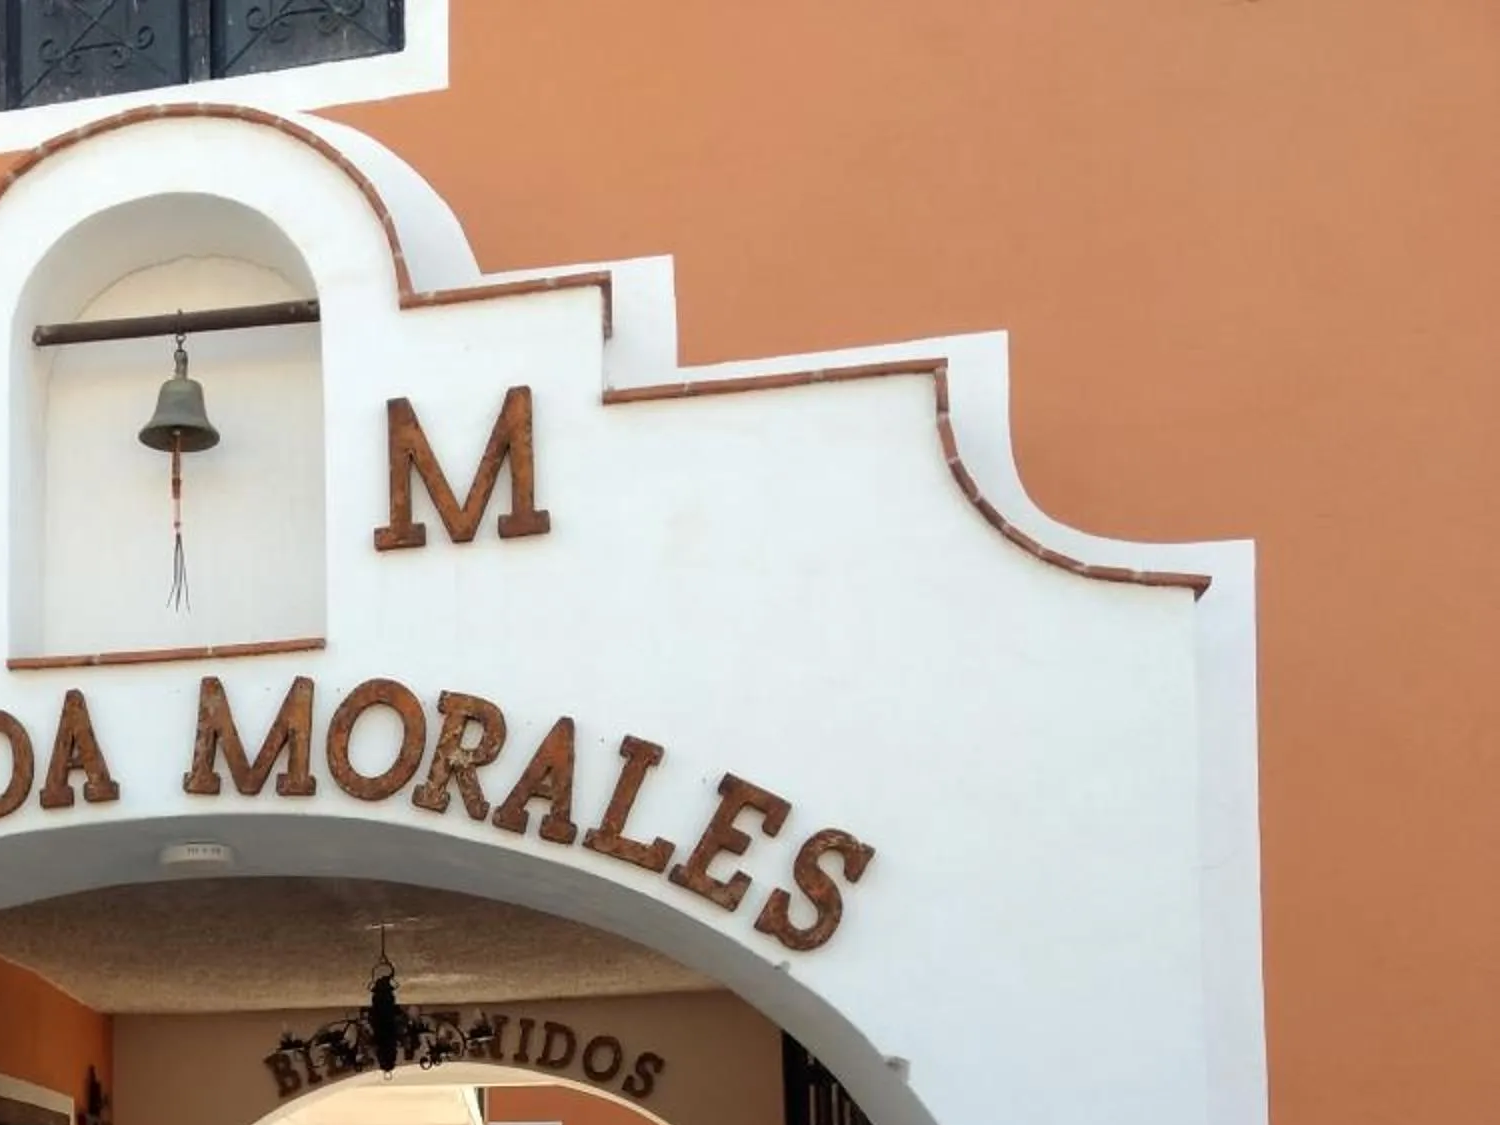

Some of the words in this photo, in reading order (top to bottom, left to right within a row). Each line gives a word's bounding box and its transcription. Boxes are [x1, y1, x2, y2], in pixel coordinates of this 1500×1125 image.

[373, 385, 551, 552] M
[182, 675, 876, 952] MORALES
[263, 1008, 666, 1099] BINIDOS
